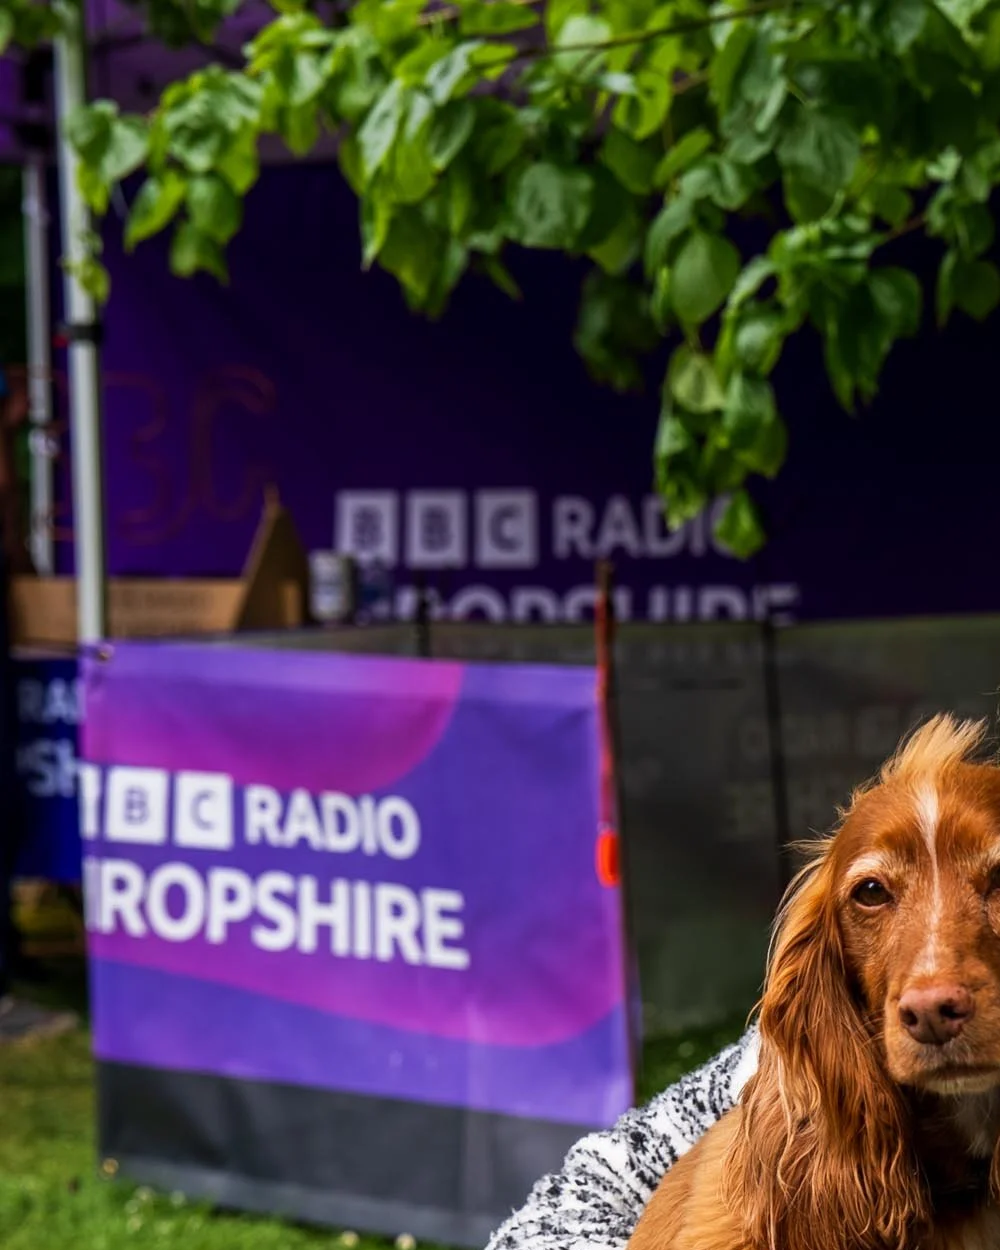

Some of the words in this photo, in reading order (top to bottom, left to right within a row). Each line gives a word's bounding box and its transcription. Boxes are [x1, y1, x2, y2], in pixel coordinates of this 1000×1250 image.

[336, 488, 538, 568] BBC
[79, 762, 234, 850] BC
[244, 786, 419, 858] RADIO
[83, 856, 469, 969] ROPSHIRE
